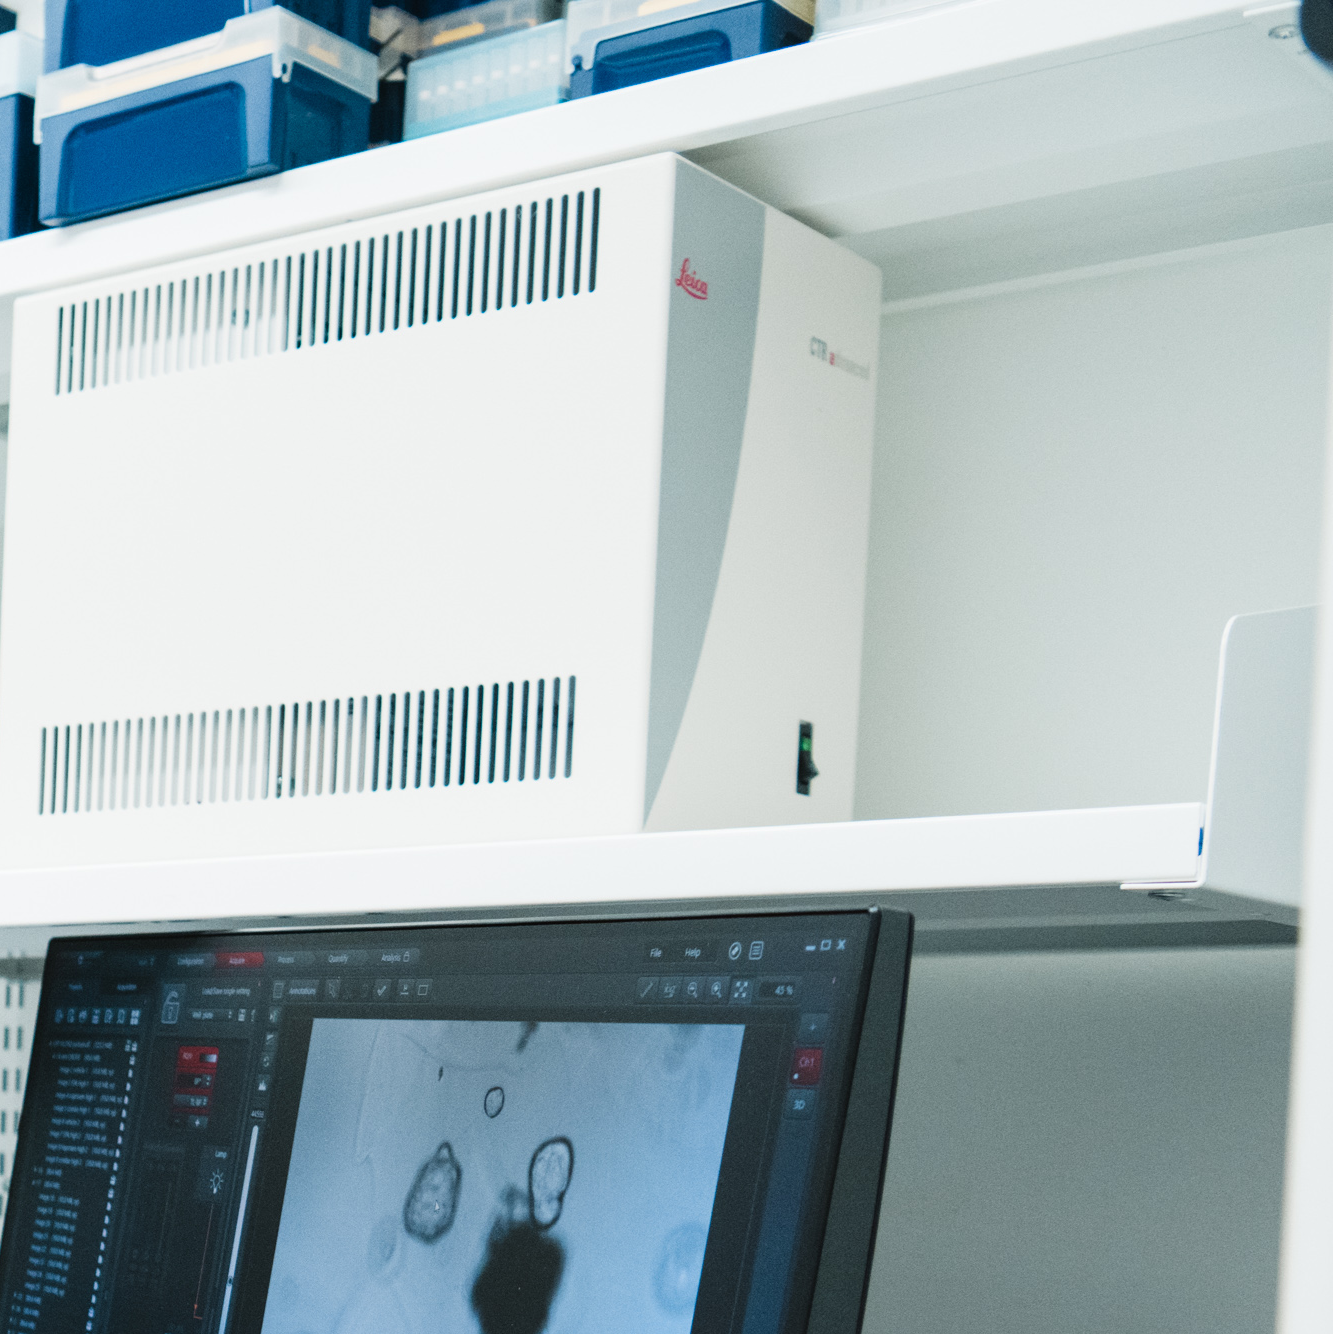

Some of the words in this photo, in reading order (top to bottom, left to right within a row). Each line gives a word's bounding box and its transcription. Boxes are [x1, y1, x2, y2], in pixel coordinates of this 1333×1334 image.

[675, 258, 708, 300] Leica
[650, 949, 662, 958] File
[685, 948, 701, 958] Help
[328, 953, 349, 965] Quantify
[381, 953, 401, 963] Analysis
[799, 1056, 815, 1067] Ch1
[793, 1100, 805, 1110] 3D
